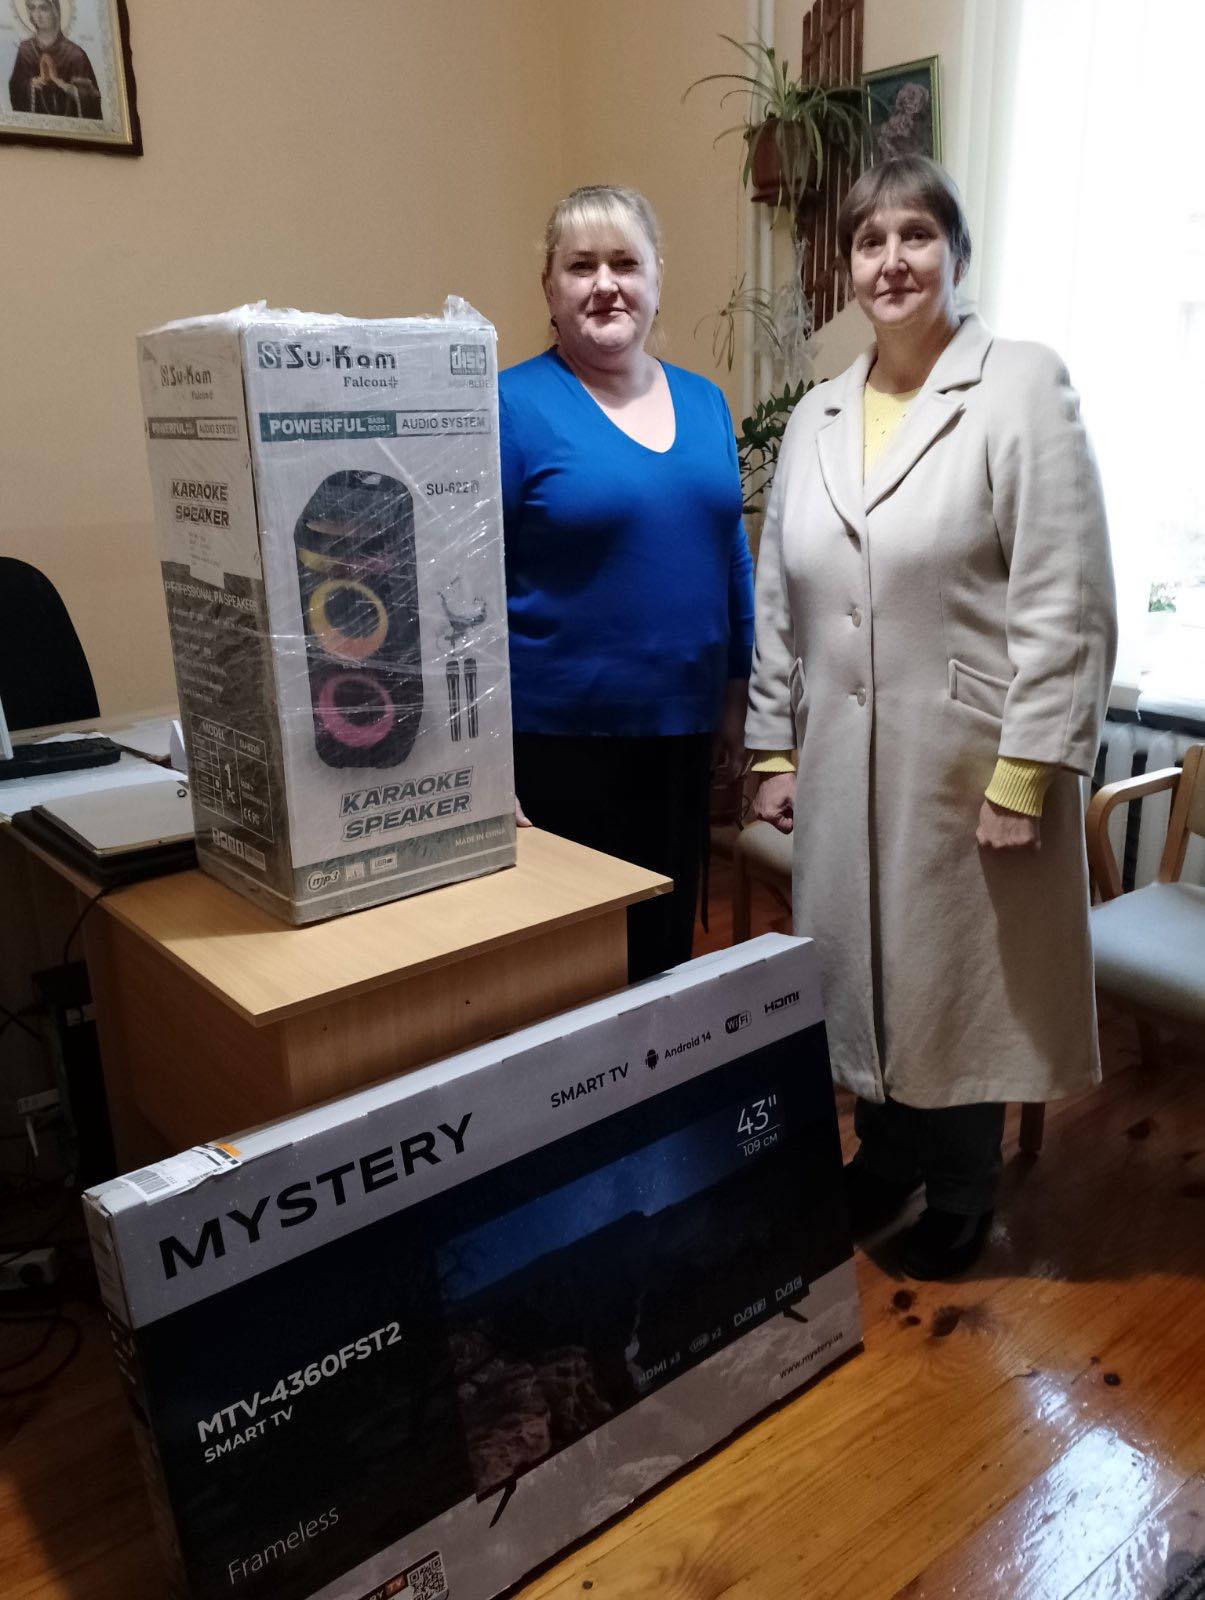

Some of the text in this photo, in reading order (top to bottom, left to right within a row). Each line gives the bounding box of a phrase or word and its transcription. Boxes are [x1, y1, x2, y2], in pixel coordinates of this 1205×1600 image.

[269, 417, 367, 435] POWERFUL
[402, 416, 485, 430] AUDIO SYSTEM
[172, 480, 228, 502] KARAOKE
[175, 504, 230, 527] SPEAKER
[202, 722, 226, 741] MODEL
[342, 769, 472, 815] KARAOKE
[345, 794, 471, 840] SPEAKER
[455, 836, 476, 847] MADE
[477, 834, 484, 842] IN
[310, 870, 339, 888] mp3
[764, 991, 800, 1014] HDMI
[664, 1031, 712, 1060] Android 14
[551, 1062, 630, 1108] SMART TV
[742, 1141, 761, 1157] 109
[158, 1112, 473, 1280] MYSTERY
[779, 1332, 844, 1379] www.mystery.ua
[197, 1321, 402, 1443] MTV-4360FST2
[638, 1358, 667, 1385] HDMI
[204, 1405, 293, 1463] SMART TV
[228, 1506, 340, 1585] Frameless
